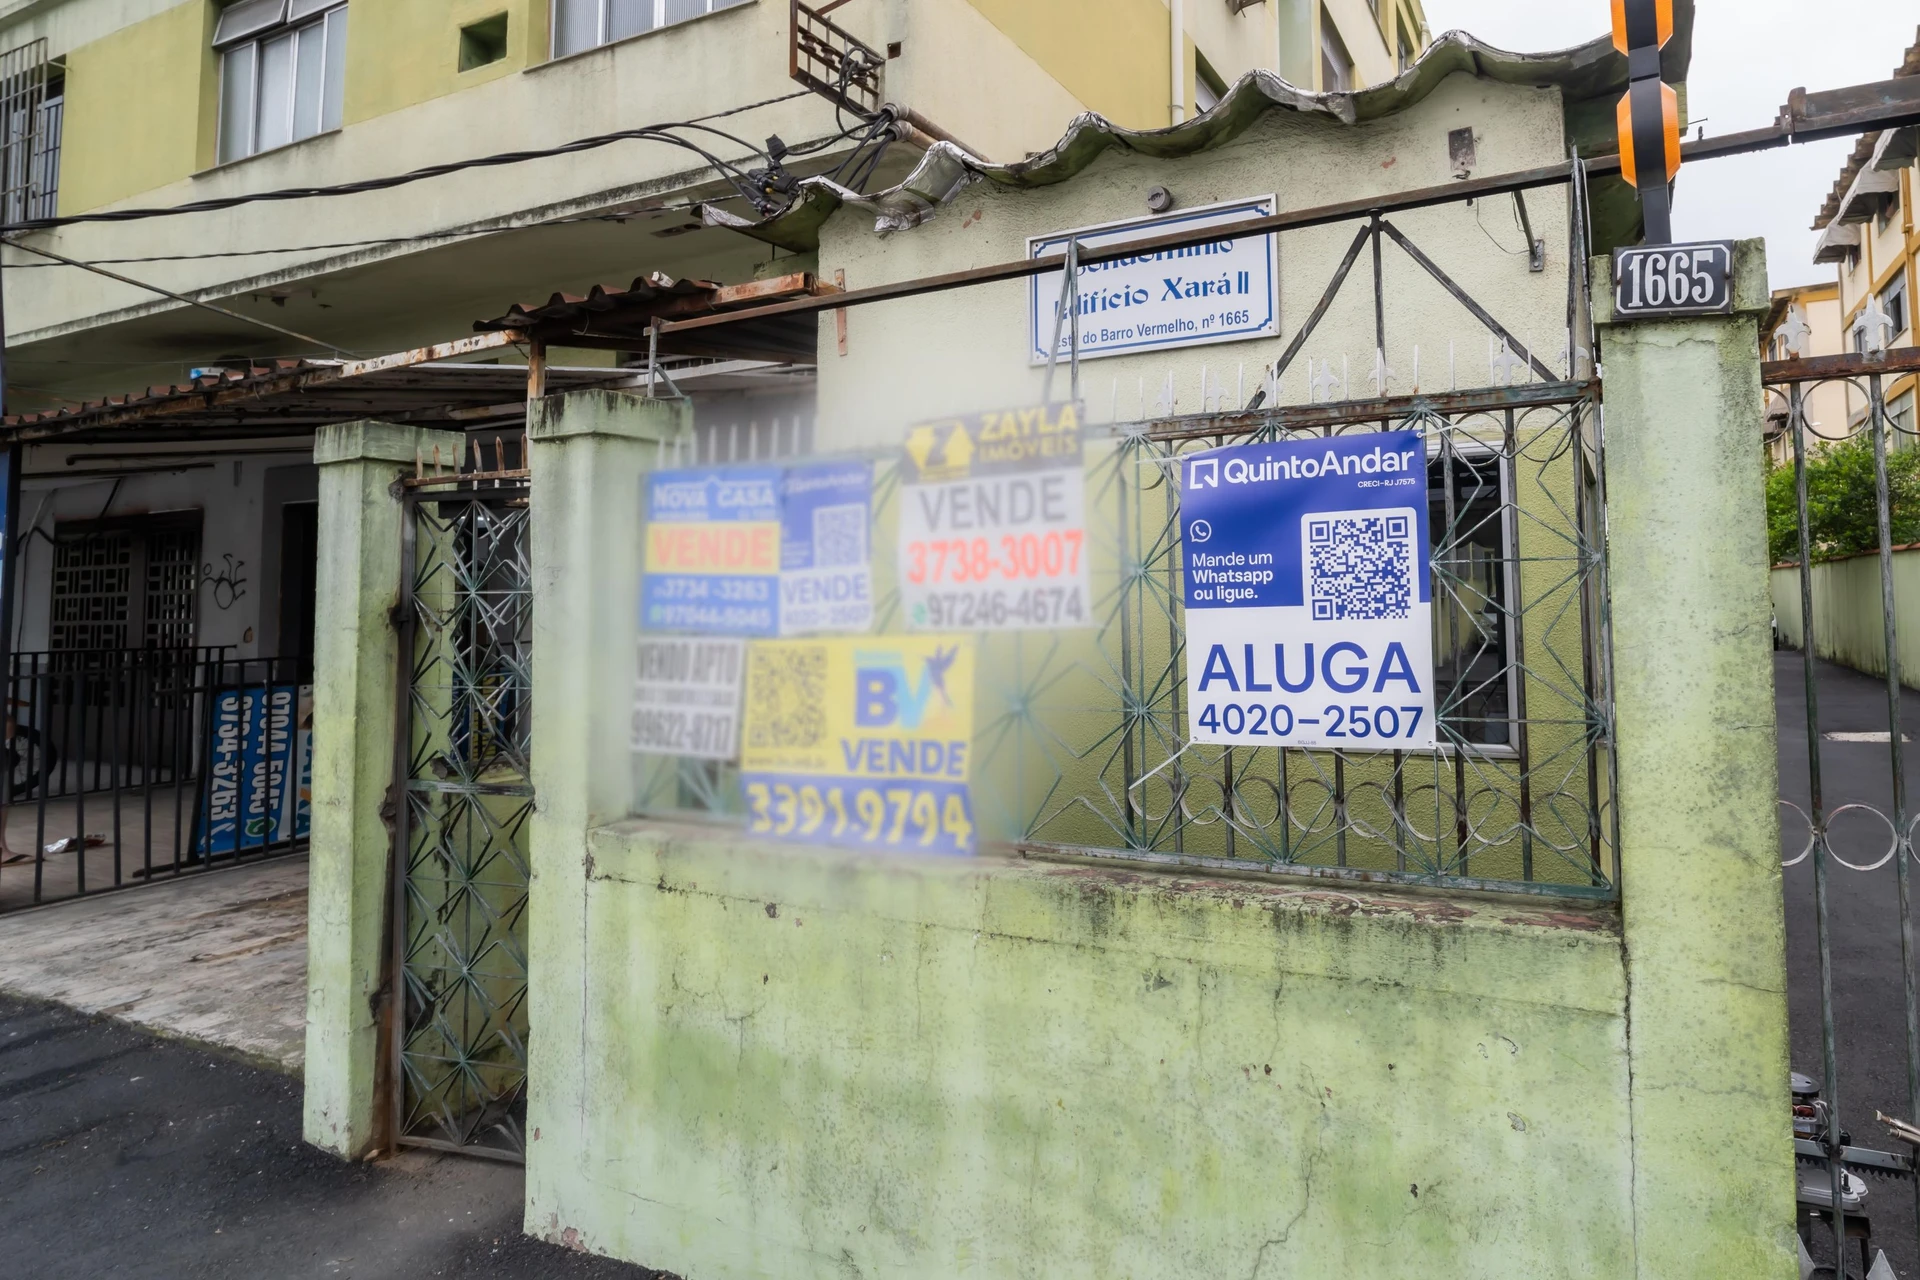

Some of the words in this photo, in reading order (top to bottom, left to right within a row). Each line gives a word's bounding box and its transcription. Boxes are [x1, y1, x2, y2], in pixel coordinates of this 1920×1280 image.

[1161, 271, 1231, 301] Xará
[1237, 271, 1249, 294] II
[1628, 250, 1714, 307] 1665
[1082, 331, 1097, 344] do
[1101, 327, 1133, 342] Barro
[1137, 318, 1198, 337] Vermelho,
[1202, 313, 1215, 328] nº
[1219, 310, 1249, 326] 1665
[980, 403, 1078, 442] ZAYLA
[1223, 446, 1415, 485] QuintoAndar
[1357, 479, 1394, 488] CRECI-RJ
[918, 476, 1067, 532] VENDE
[653, 527, 773, 568] VENDE
[907, 528, 1085, 584] 3738-3007
[1192, 551, 1245, 567] Mande
[1249, 553, 1273, 565] um
[782, 573, 869, 604] VENDE
[1193, 569, 1274, 585] Whatsapp
[1194, 589, 1213, 600] ou
[1217, 585, 1258, 602] ligue.
[1198, 641, 1421, 694] ALUGA
[1198, 703, 1424, 739] 4020-2507
[840, 738, 968, 777] VENDE
